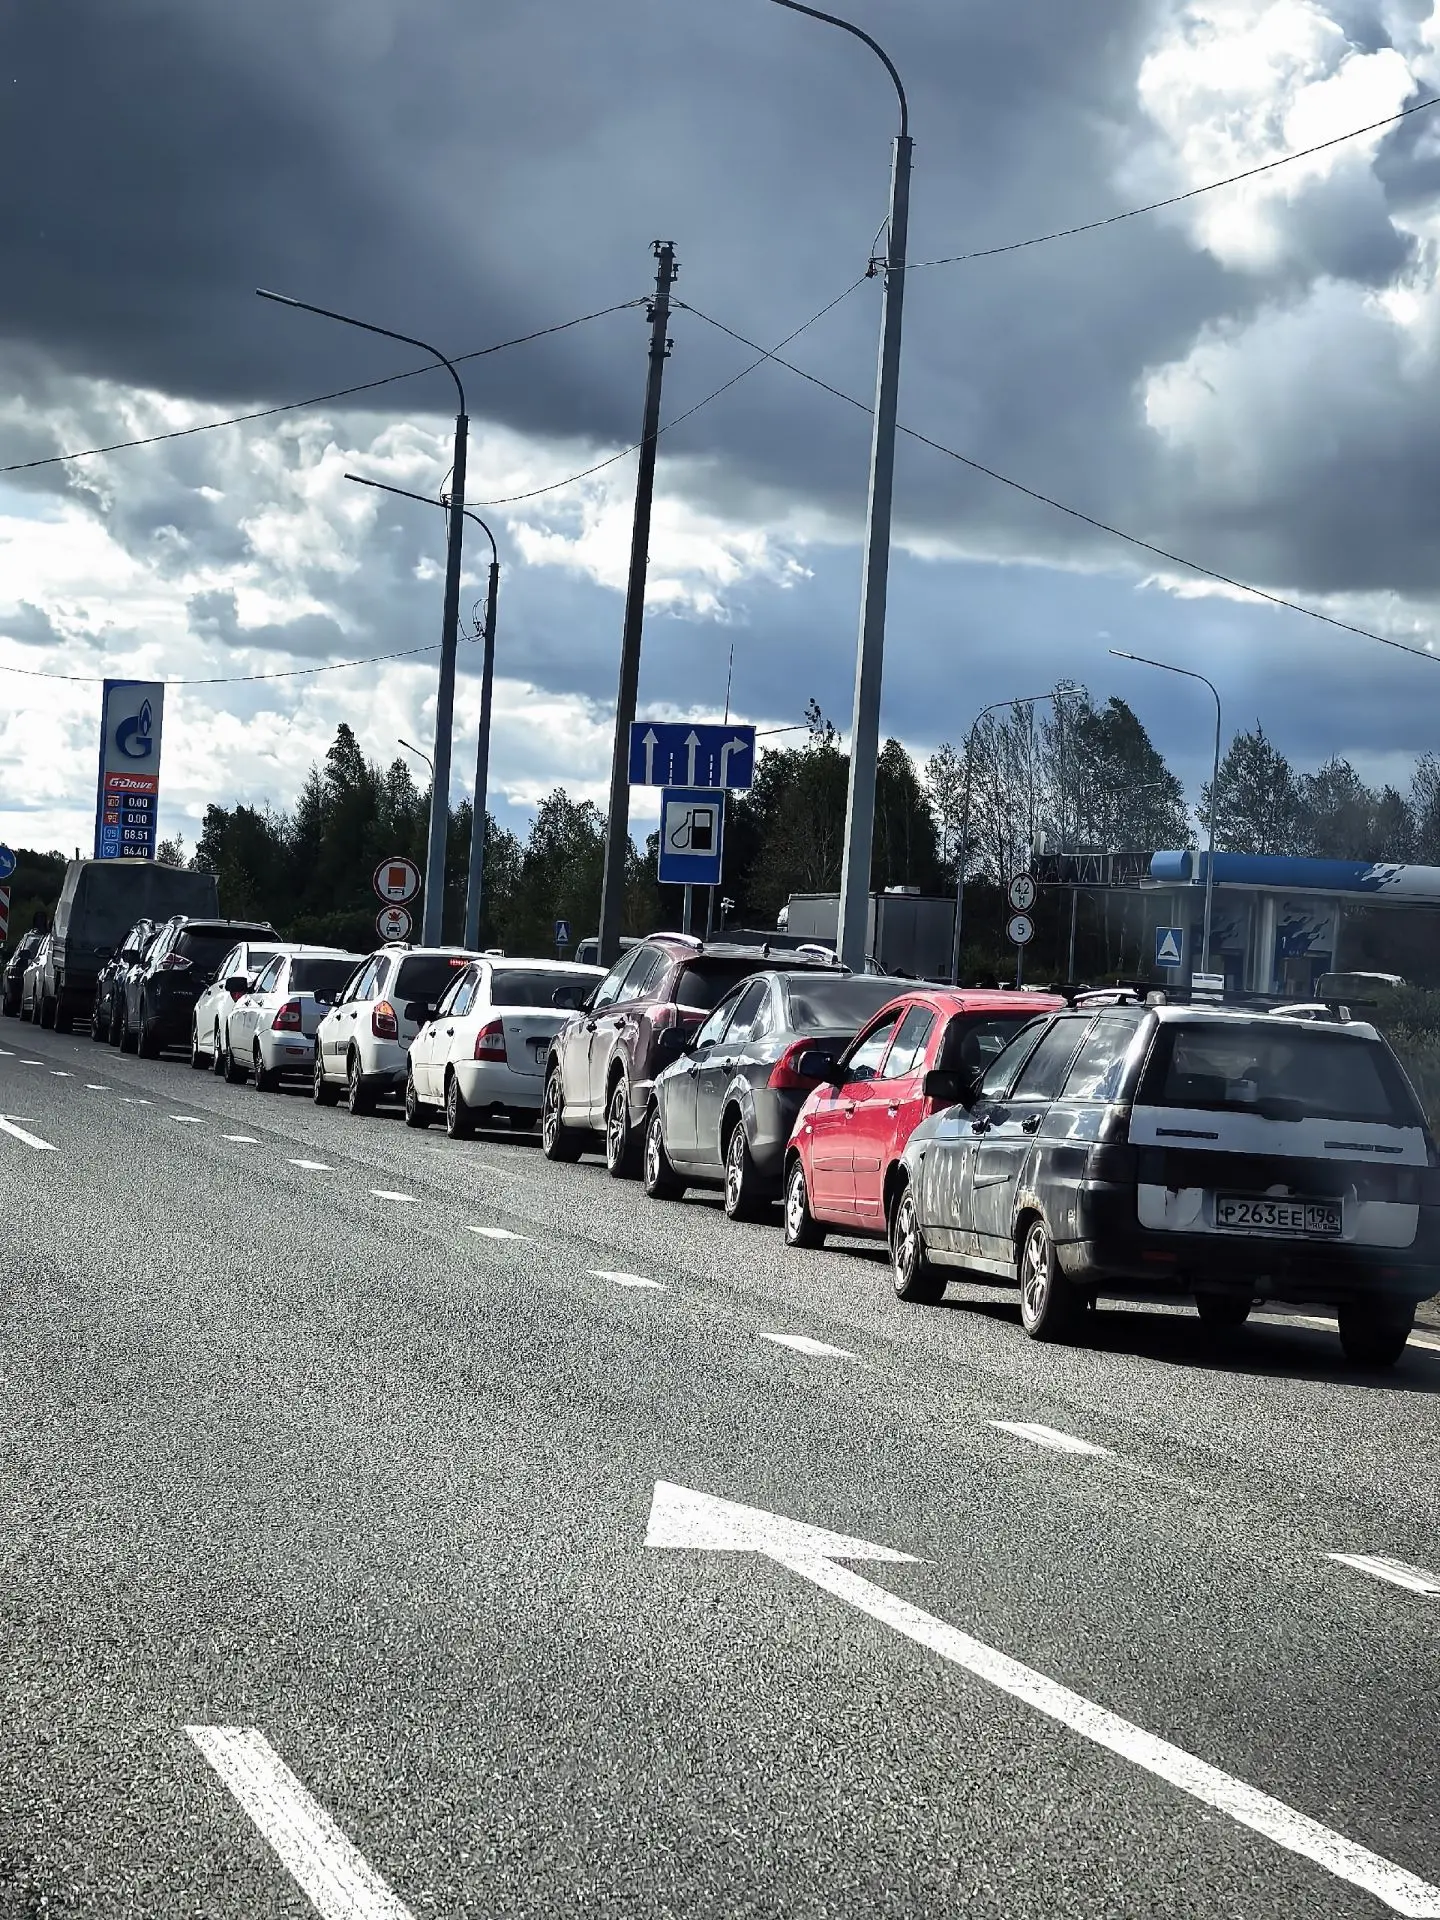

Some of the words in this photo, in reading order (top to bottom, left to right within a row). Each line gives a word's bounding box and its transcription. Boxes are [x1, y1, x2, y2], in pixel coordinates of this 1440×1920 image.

[128, 797, 148, 808] 0.00
[128, 813, 147, 824] 0.00
[124, 829, 148, 840] 68.51
[106, 845, 115, 854] 92
[124, 846, 148, 857] 64.40
[1018, 924, 1025, 935] 5
[1307, 1207, 1336, 1224] 196
